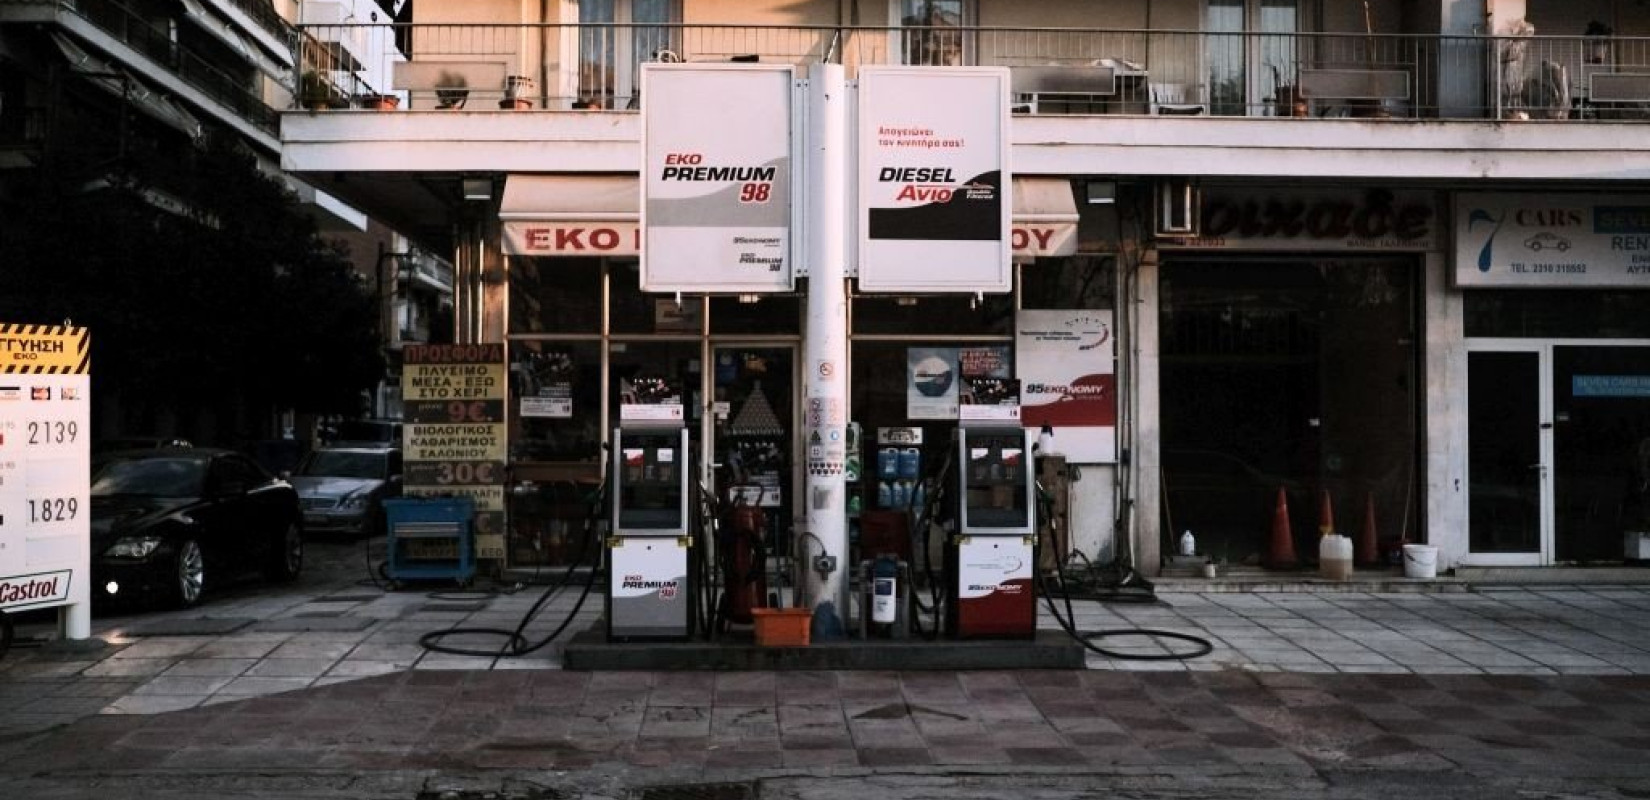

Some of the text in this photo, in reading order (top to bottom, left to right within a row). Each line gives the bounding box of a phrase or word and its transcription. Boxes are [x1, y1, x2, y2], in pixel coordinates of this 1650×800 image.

[665, 154, 702, 165] EKO
[662, 167, 776, 181] PREMIUM
[879, 167, 956, 182] DIESEL
[740, 183, 771, 202] 98
[1516, 208, 1582, 227] CARS
[525, 227, 620, 250] EKO
[405, 345, 501, 363] ΠΡΟΣΦΟΡΑ
[418, 366, 488, 376] ΠΛΥΣΙΜΟ
[412, 377, 452, 388] ΜΕΣΑ
[465, 377, 494, 387] ΕΞΩ
[1026, 383, 1103, 394] 95EKONOMY
[418, 388, 488, 398] ΣΤΟ ΧΕΡΙ
[28, 420, 78, 444] 2139
[413, 425, 494, 436] ΒΙΟΛΟΓΙΚΟΣ
[410, 437, 497, 447] ΚΑΘΑΡΙΣΜΟΣ
[419, 448, 488, 458] ΣΑΛΟΝΙΟΥ
[436, 463, 494, 485] 30€
[29, 497, 78, 523] 1.829
[0, 576, 58, 603] Castrol
[622, 581, 677, 589] PREMIUM
